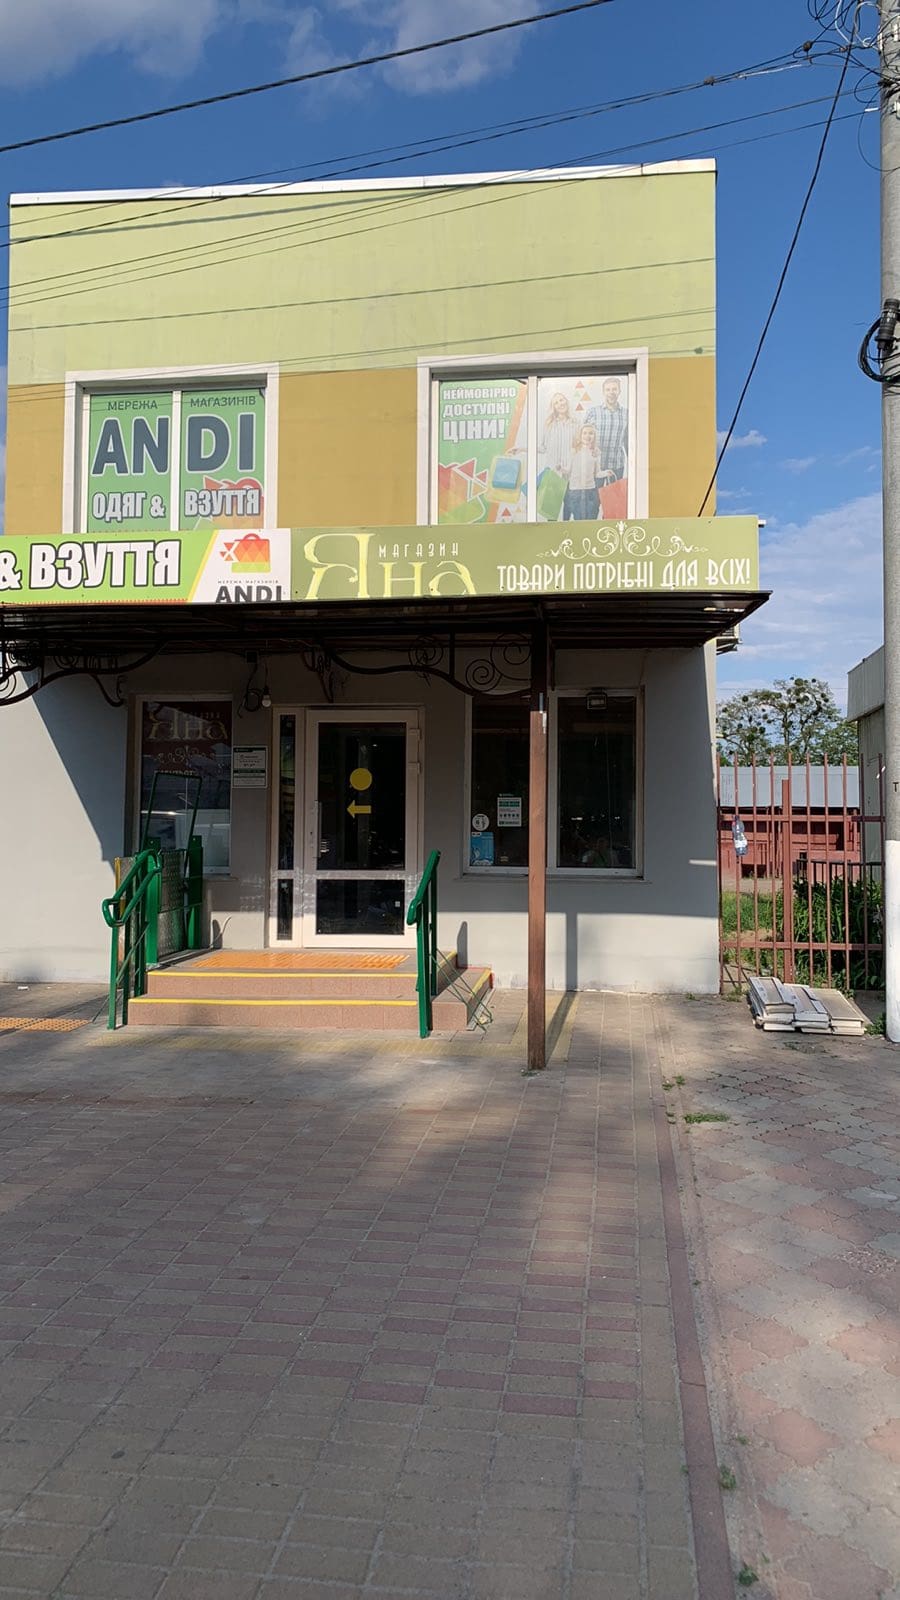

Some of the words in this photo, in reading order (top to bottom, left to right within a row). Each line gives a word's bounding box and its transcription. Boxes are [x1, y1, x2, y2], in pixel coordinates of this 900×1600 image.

[107, 401, 158, 411] МЕРЕЖА
[190, 396, 256, 407] МАГАЗИНІВ
[443, 387, 516, 400] НЕЙМОВІРНО
[443, 402, 511, 418] ДОСТУПНІ
[443, 419, 505, 443] ЦІНИ!
[91, 412, 256, 476] ANDI
[92, 491, 147, 523] ОДЯГ
[150, 495, 166, 518] &
[184, 488, 260, 518] ВЗУТТЯ
[378, 543, 459, 558] МАГАЗИН
[29, 539, 182, 590] ВЗУТТЯ
[497, 564, 565, 592] ТОВАРИ
[573, 561, 654, 589] ПОТРІБНІ
[660, 560, 698, 590] ДЛЯ
[705, 558, 750, 585] ВСІХ!
[215, 585, 282, 603] ANDI
